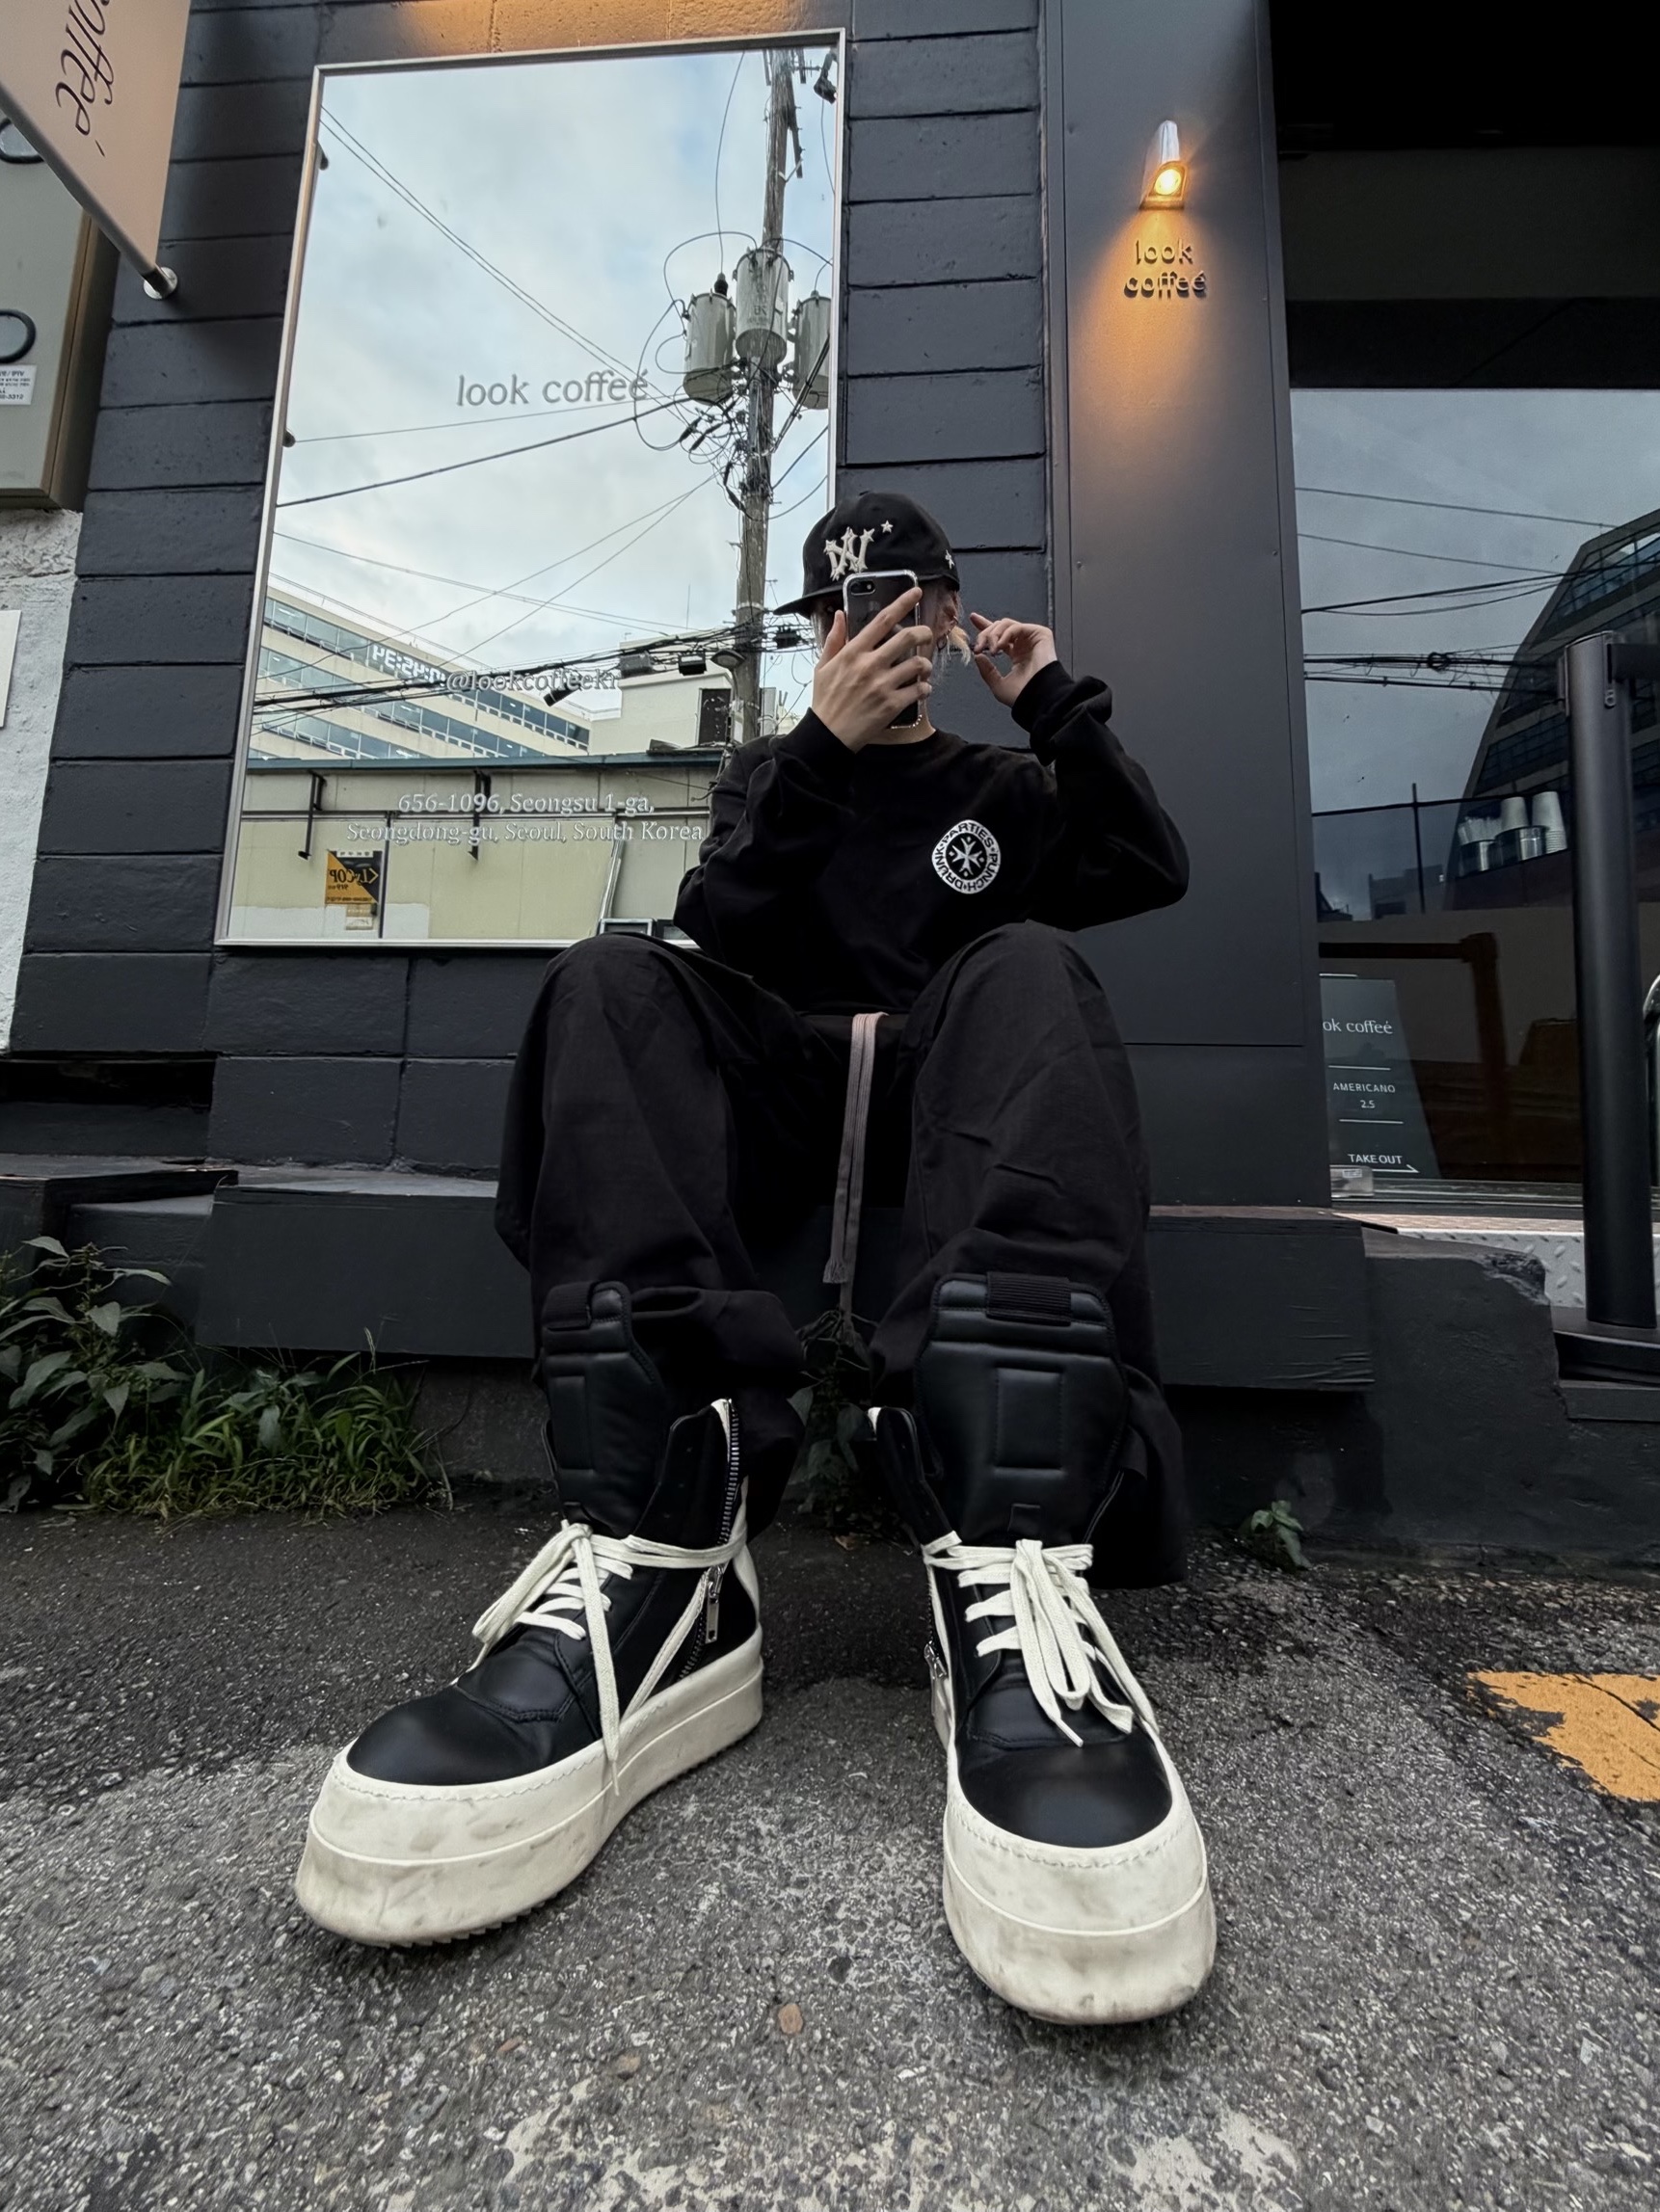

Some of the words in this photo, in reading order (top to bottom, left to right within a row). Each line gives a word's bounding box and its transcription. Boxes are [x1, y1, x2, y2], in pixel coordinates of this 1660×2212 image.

[55, 0, 114, 157] offeé
[1136, 239, 1193, 265] look
[457, 373, 529, 406] look
[398, 793, 505, 813] 656-1096,
[510, 793, 599, 816] Seongsu
[604, 793, 655, 816] 1-ga,
[347, 822, 498, 845] Seongdong-gu,
[505, 822, 567, 843] Seoul,
[573, 821, 633, 841] South
[941, 822, 995, 848] PARTIES
[934, 846, 964, 890] DRUNK
[967, 853, 998, 892] PUNCH
[1323, 1018, 1342, 1032] ok
[1332, 1082, 1396, 1094] AMERICANO
[1360, 1100, 1376, 1109] 2.5
[1348, 1154, 1379, 1164] TAKE
[1379, 1155, 1403, 1164] OUT
